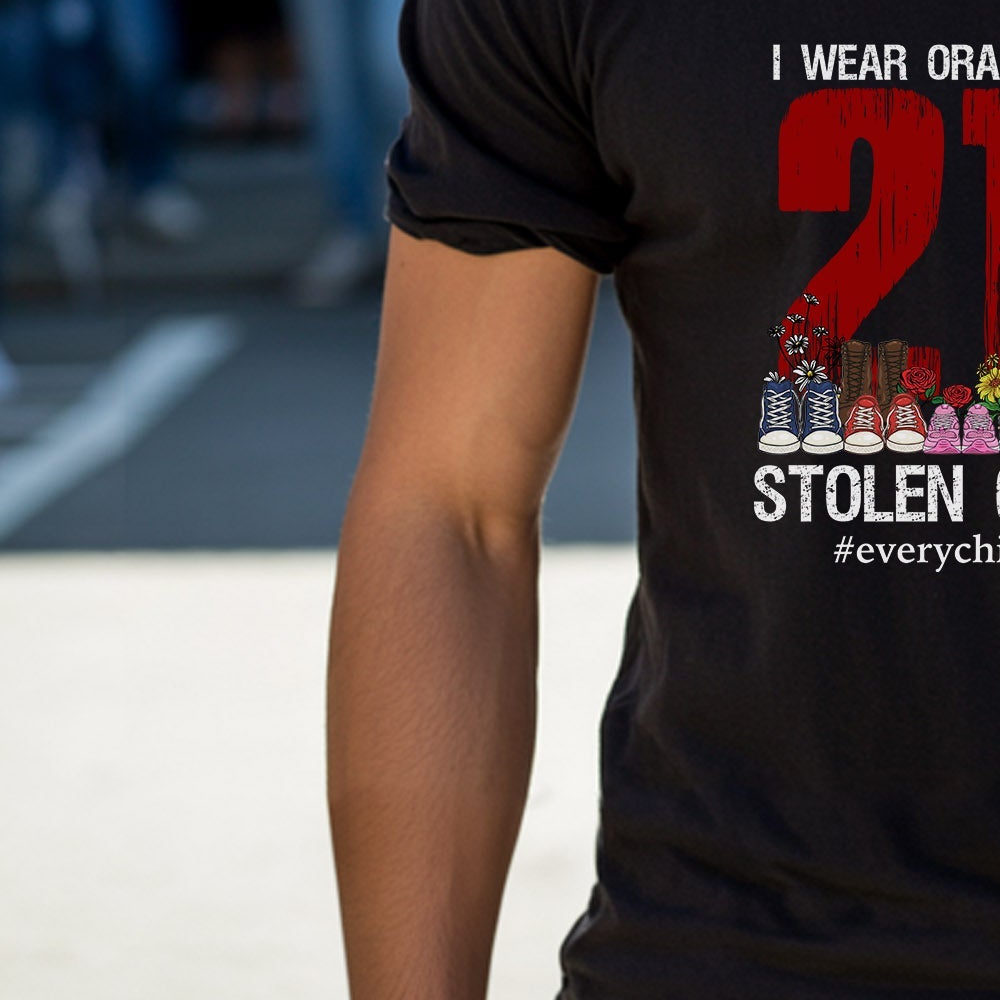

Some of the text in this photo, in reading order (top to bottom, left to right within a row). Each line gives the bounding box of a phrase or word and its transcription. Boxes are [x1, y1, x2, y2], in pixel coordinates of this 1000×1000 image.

[772, 44, 781, 81] I
[800, 44, 908, 81] WEAR
[753, 464, 964, 523] STOLEN
